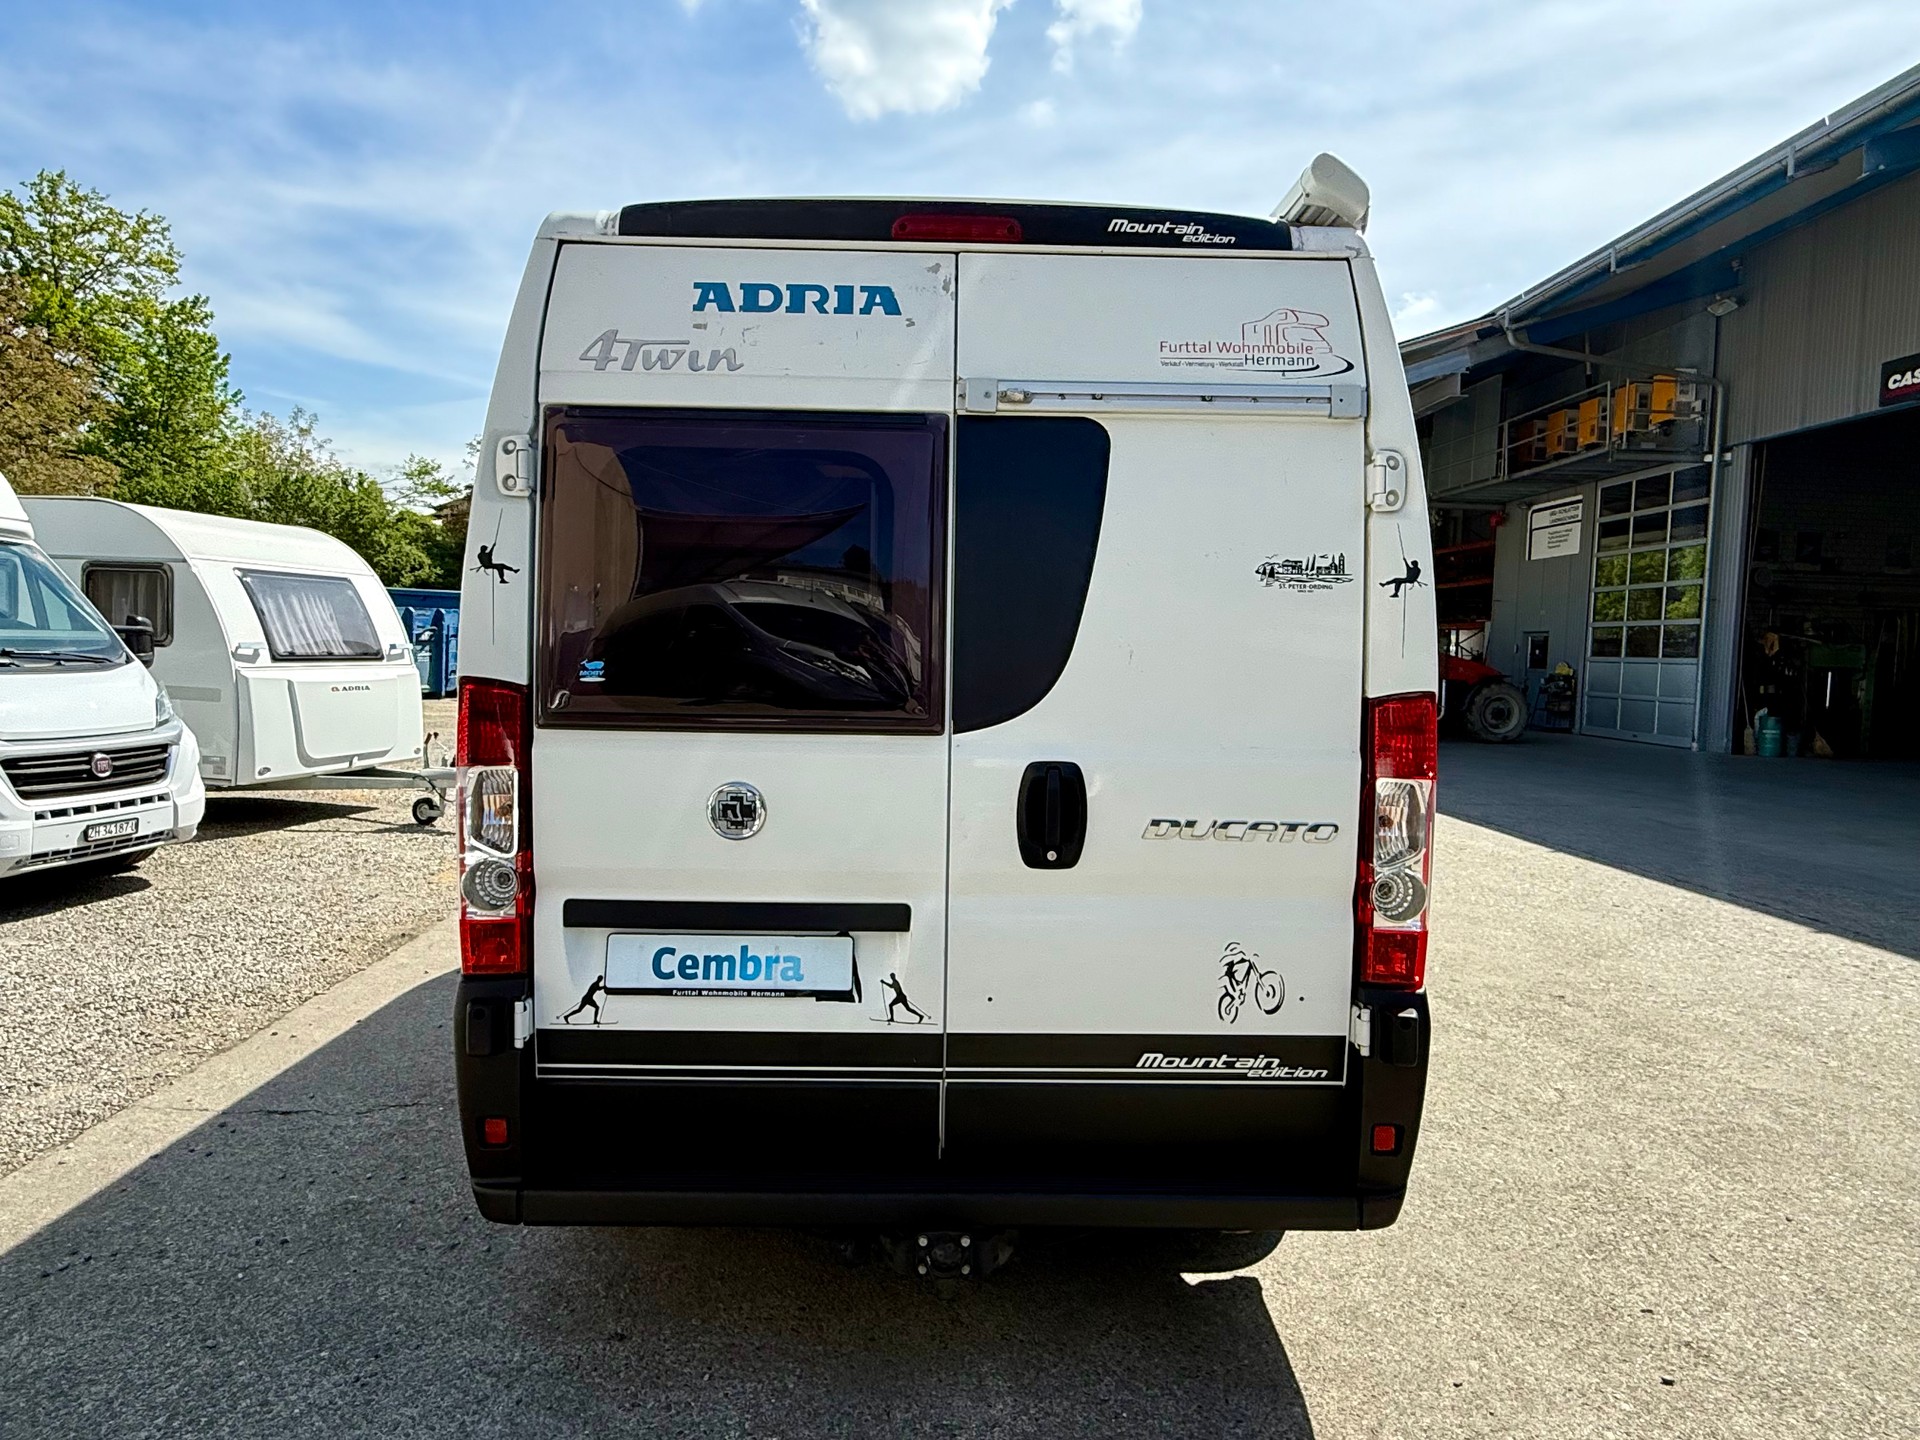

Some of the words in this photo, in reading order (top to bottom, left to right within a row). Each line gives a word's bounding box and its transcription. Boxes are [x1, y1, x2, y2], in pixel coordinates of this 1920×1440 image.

[1107, 218, 1204, 235] Mountain
[1182, 233, 1236, 245] edition
[691, 281, 903, 316] ADRIA
[578, 328, 745, 372] 4Twin
[1159, 340, 1212, 354] Furttal
[1216, 341, 1314, 355] Wohnmobile
[1244, 353, 1315, 366] Hermann
[1141, 818, 1340, 844] DUCATO
[652, 945, 804, 982] Cembra
[1136, 1052, 1281, 1069] Mountain
[1246, 1066, 1329, 1079] edition
